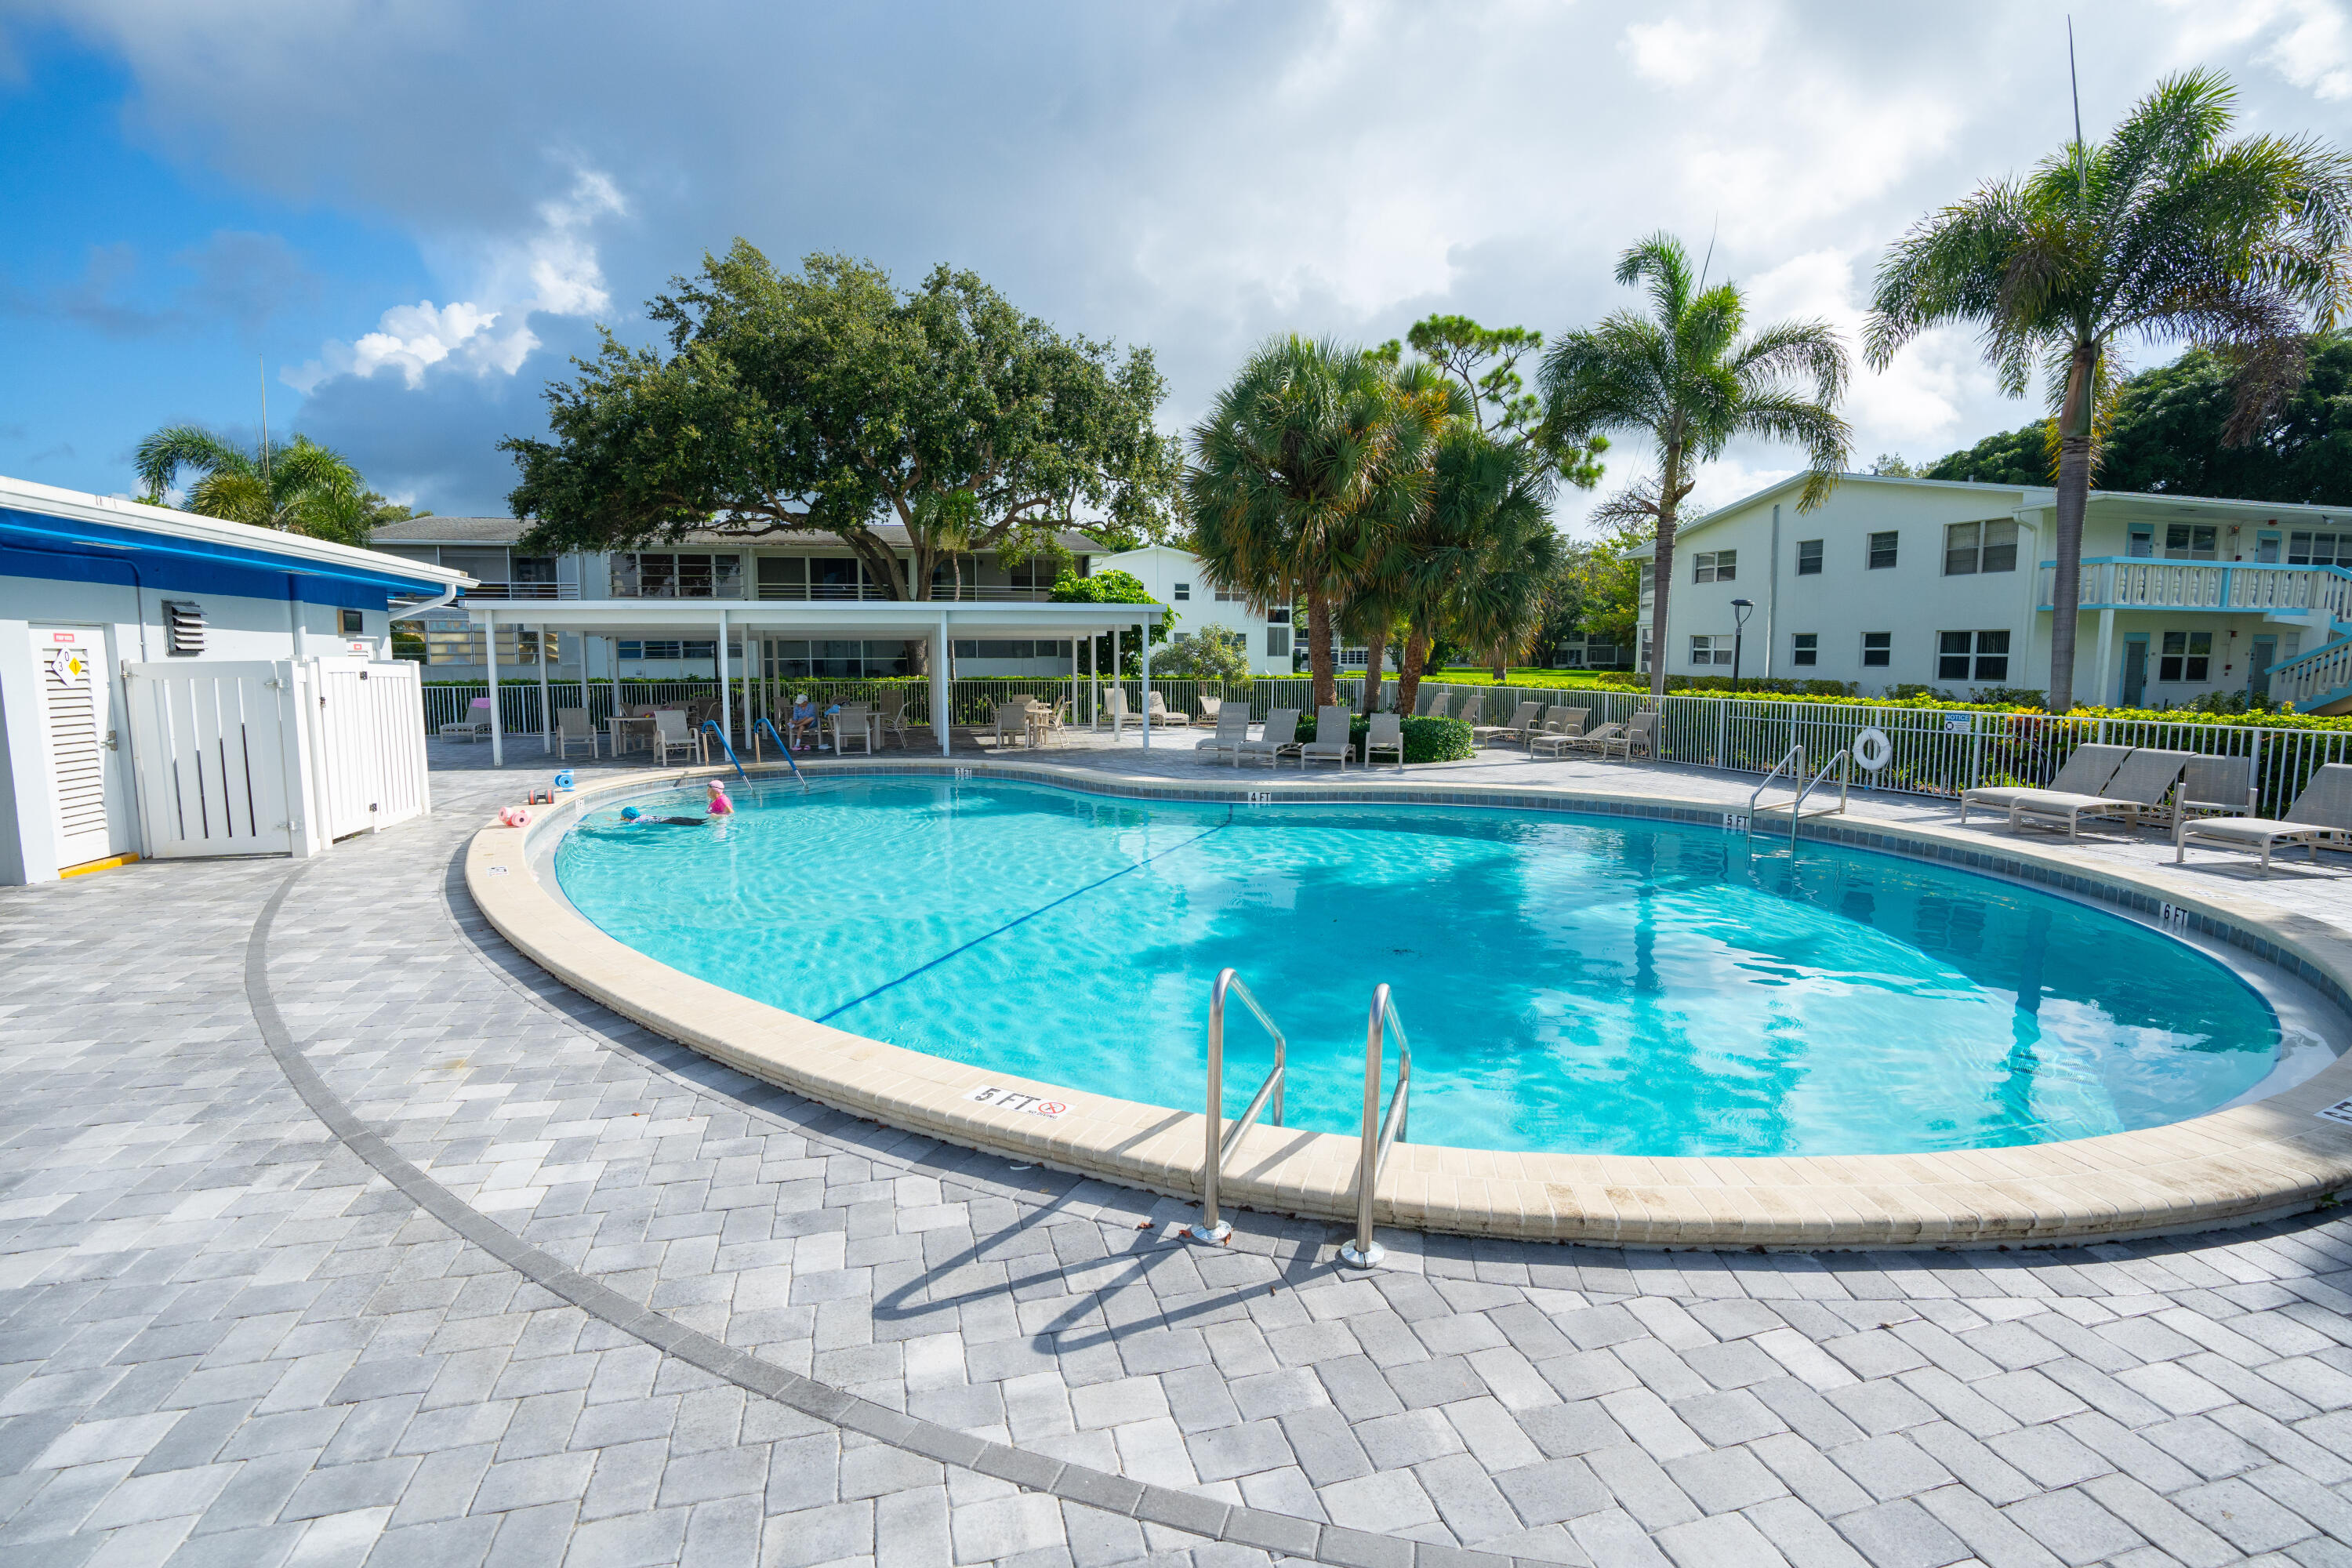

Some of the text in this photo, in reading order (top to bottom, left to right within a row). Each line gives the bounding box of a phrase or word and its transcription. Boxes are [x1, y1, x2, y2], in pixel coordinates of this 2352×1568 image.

[65, 652, 69, 661] 0
[59, 662, 63, 671] 3
[1251, 793, 1270, 801] 4 FT
[1727, 815, 1749, 828] 5 FT
[2164, 904, 2187, 925] 6 FT
[975, 1088, 1041, 1109] 5 FT
